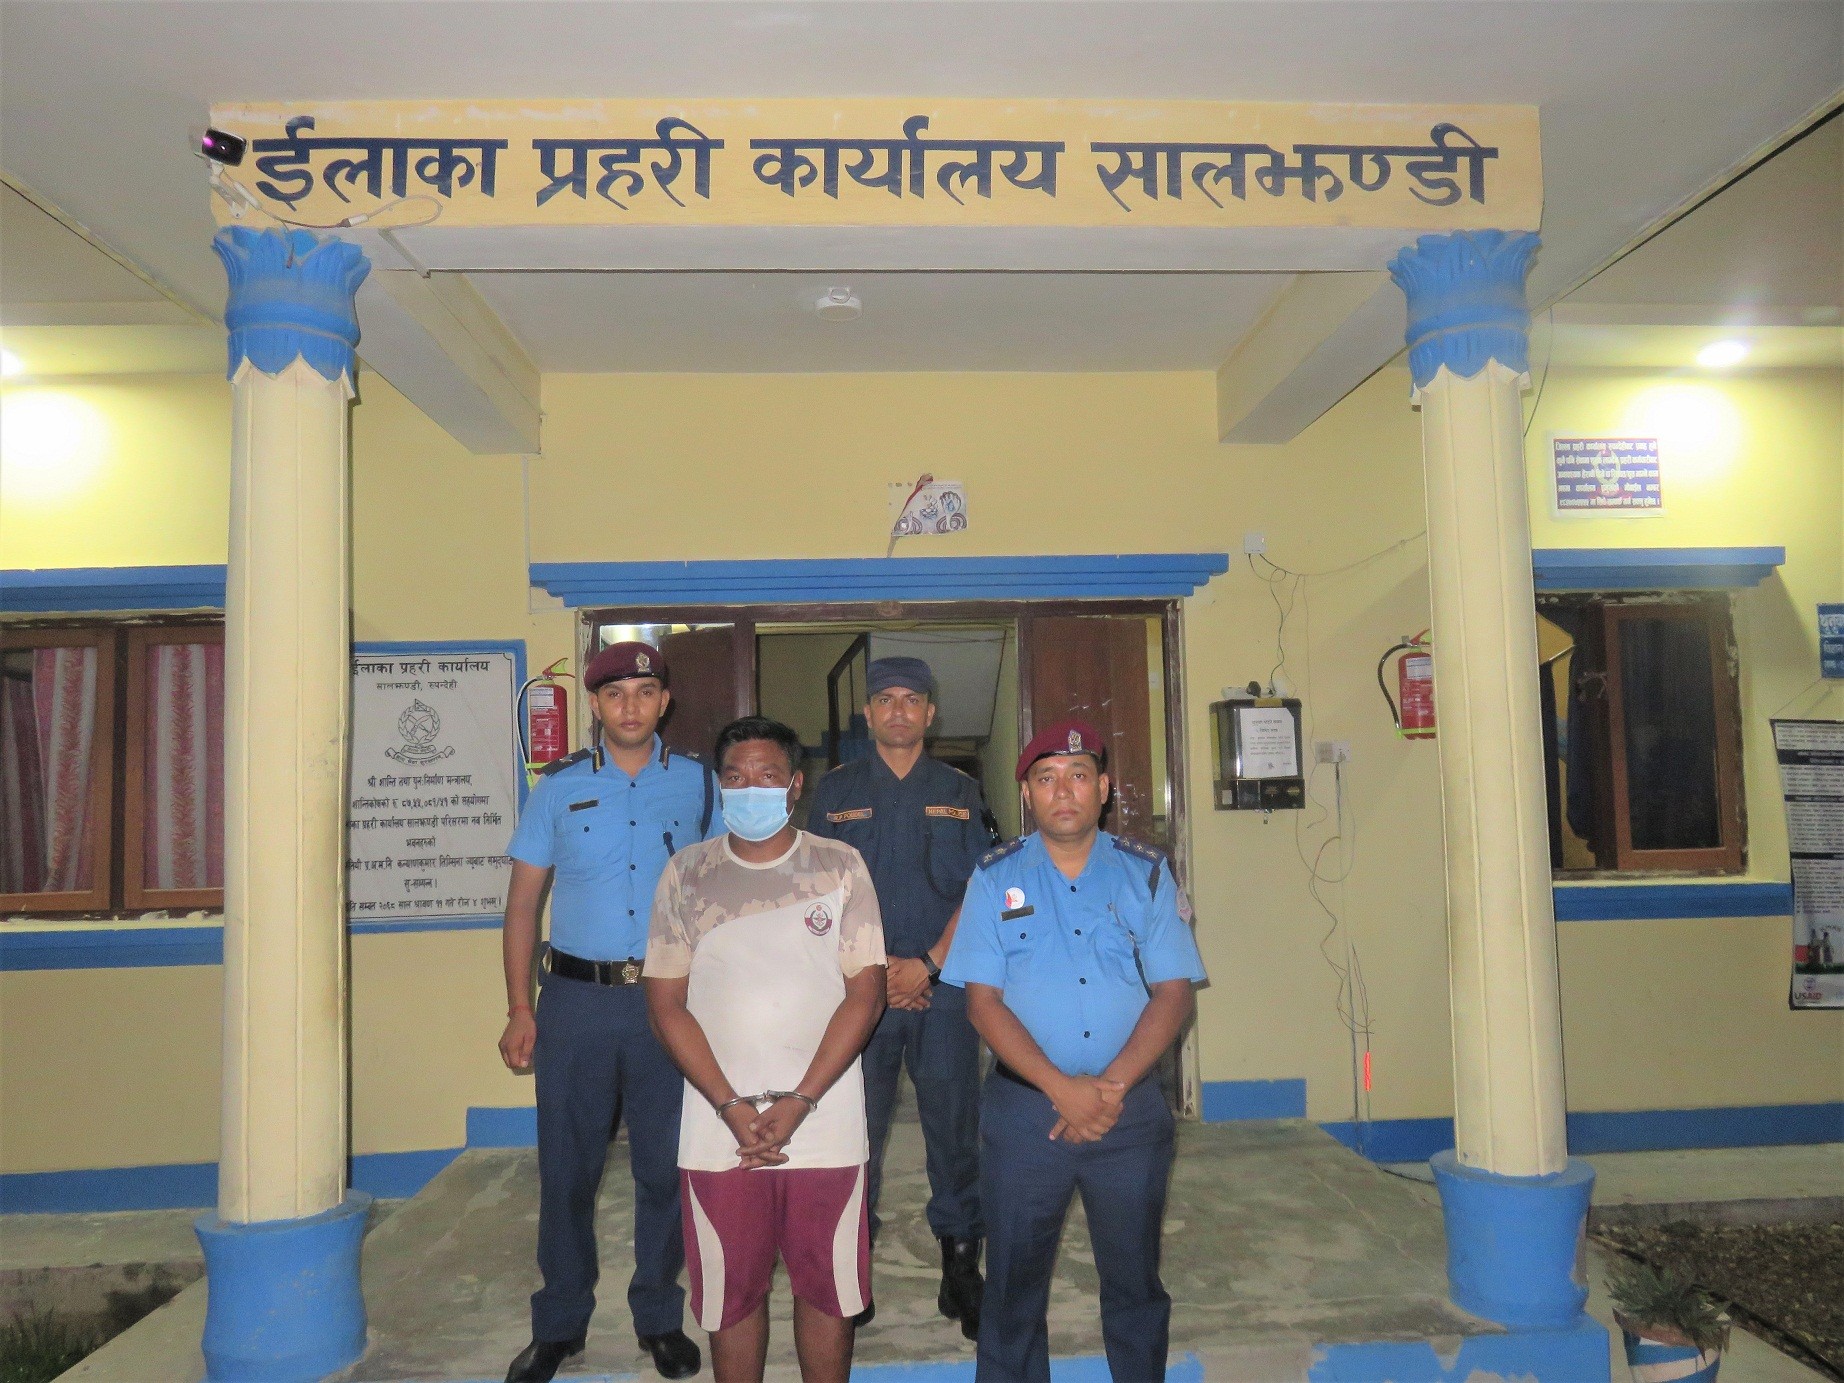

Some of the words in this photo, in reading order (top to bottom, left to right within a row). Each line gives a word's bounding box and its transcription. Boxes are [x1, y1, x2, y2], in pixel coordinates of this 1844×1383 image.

[253, 115, 508, 211] ईलाका
[532, 117, 724, 210] प्रहरी
[751, 115, 1065, 204] कार्यालय
[1091, 123, 1498, 211] सालझण्डी
[400, 658, 431, 675] प्रहरी
[438, 657, 490, 673] कार्यालय
[368, 775, 376, 788] श्री
[379, 774, 396, 787] शान्ति
[398, 776, 411, 787] तथा
[362, 816, 379, 830] प्रहरी
[380, 815, 406, 829] कार्यालय
[1794, 992, 1822, 1001] USAID
